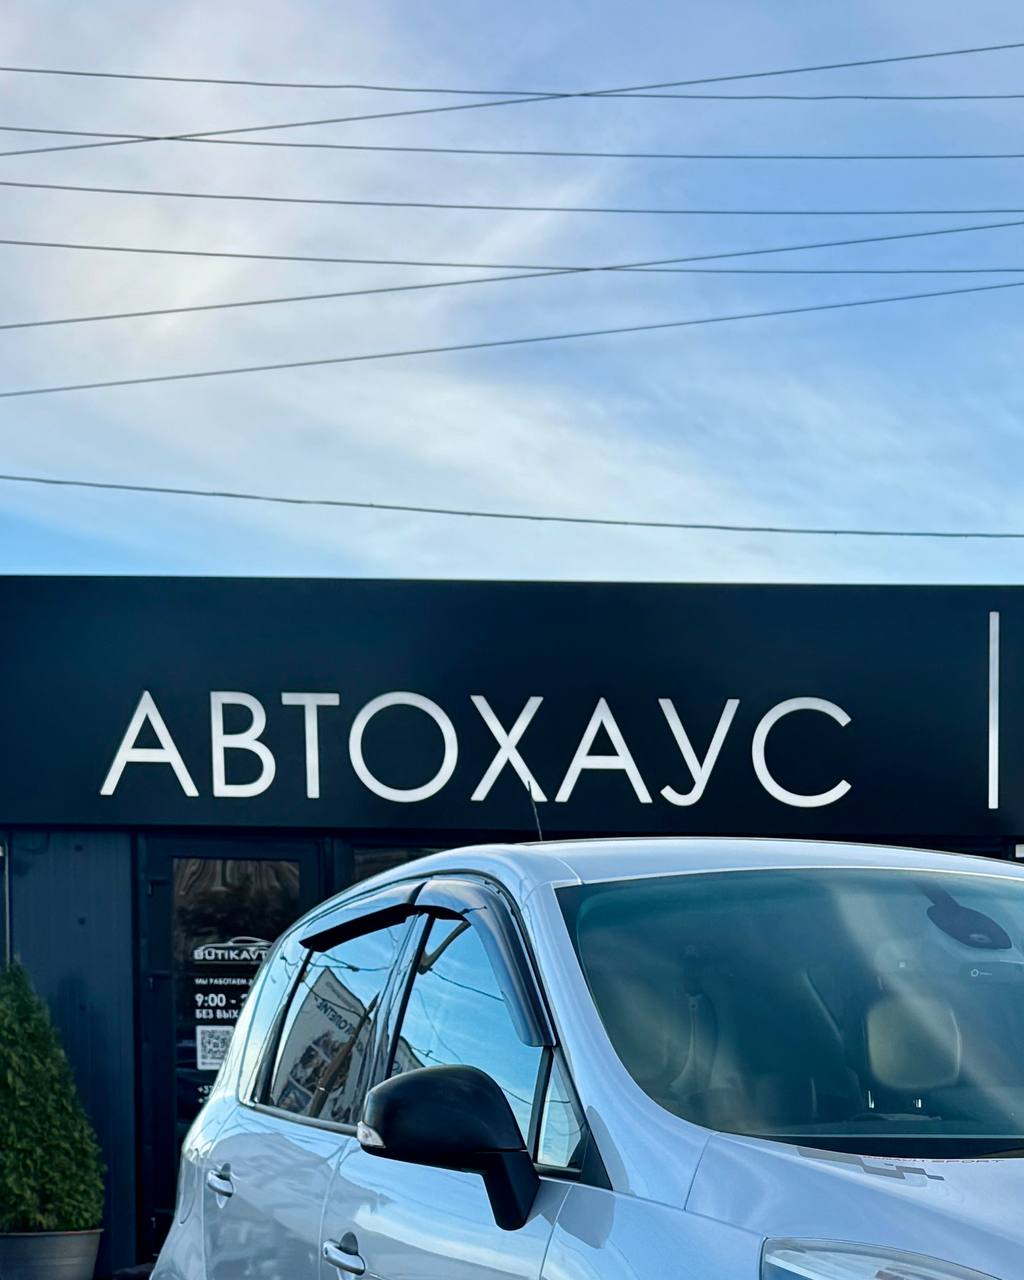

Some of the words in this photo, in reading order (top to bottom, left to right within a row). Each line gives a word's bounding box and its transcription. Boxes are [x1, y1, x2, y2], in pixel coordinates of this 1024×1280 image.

[100, 690, 852, 807] АВТОХАУС
[193, 949, 268, 961] BUTIKAVT
[194, 993, 226, 1007] 9:00
[195, 1008, 215, 1020] БЕЗ
